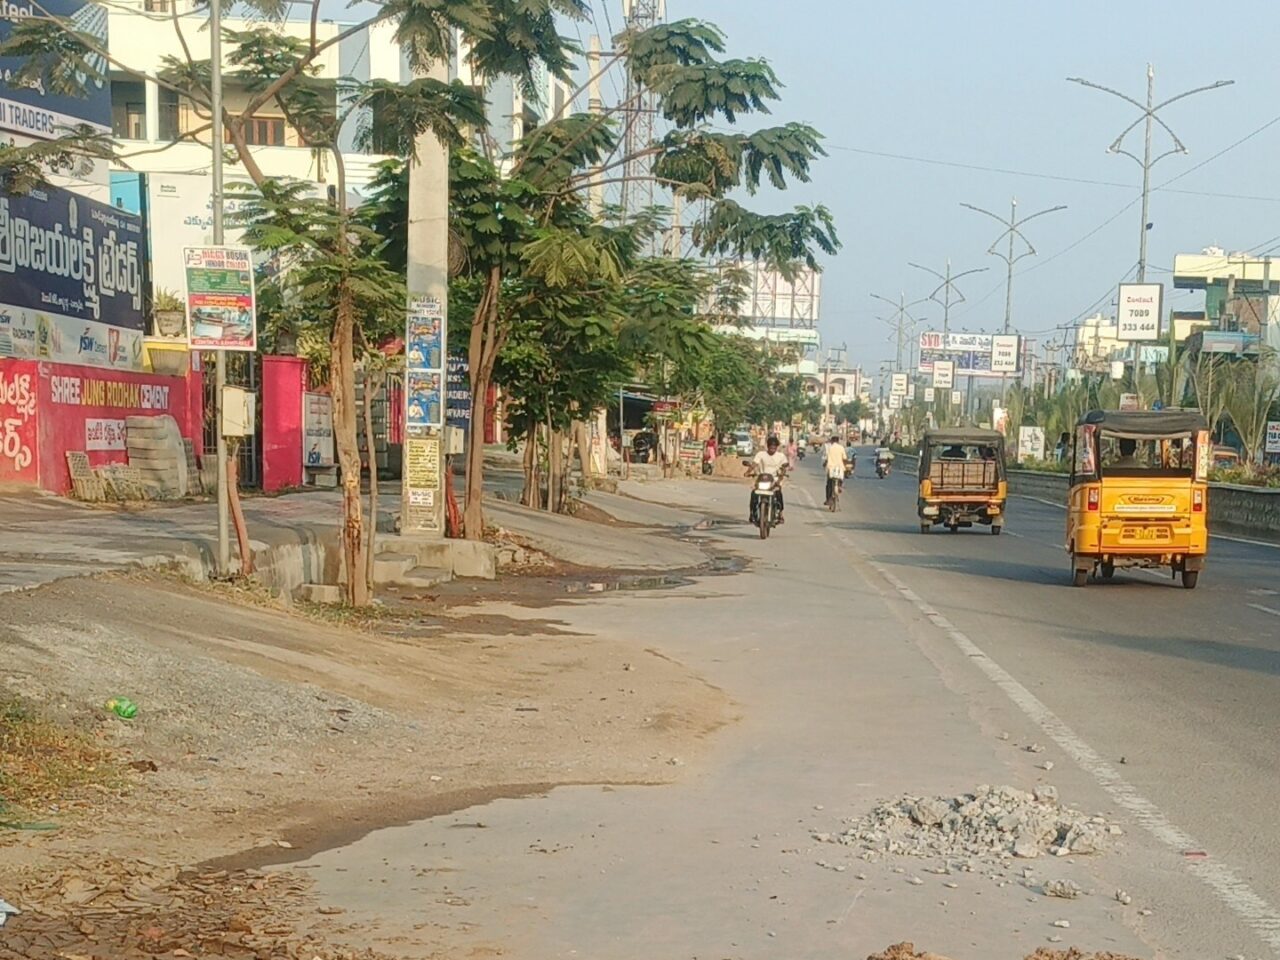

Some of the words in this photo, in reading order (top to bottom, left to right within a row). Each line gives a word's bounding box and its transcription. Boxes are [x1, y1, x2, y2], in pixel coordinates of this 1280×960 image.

[9, 104, 55, 134] TRADERS
[51, 376, 81, 404] SHREE
[141, 384, 170, 410] CEMENT
